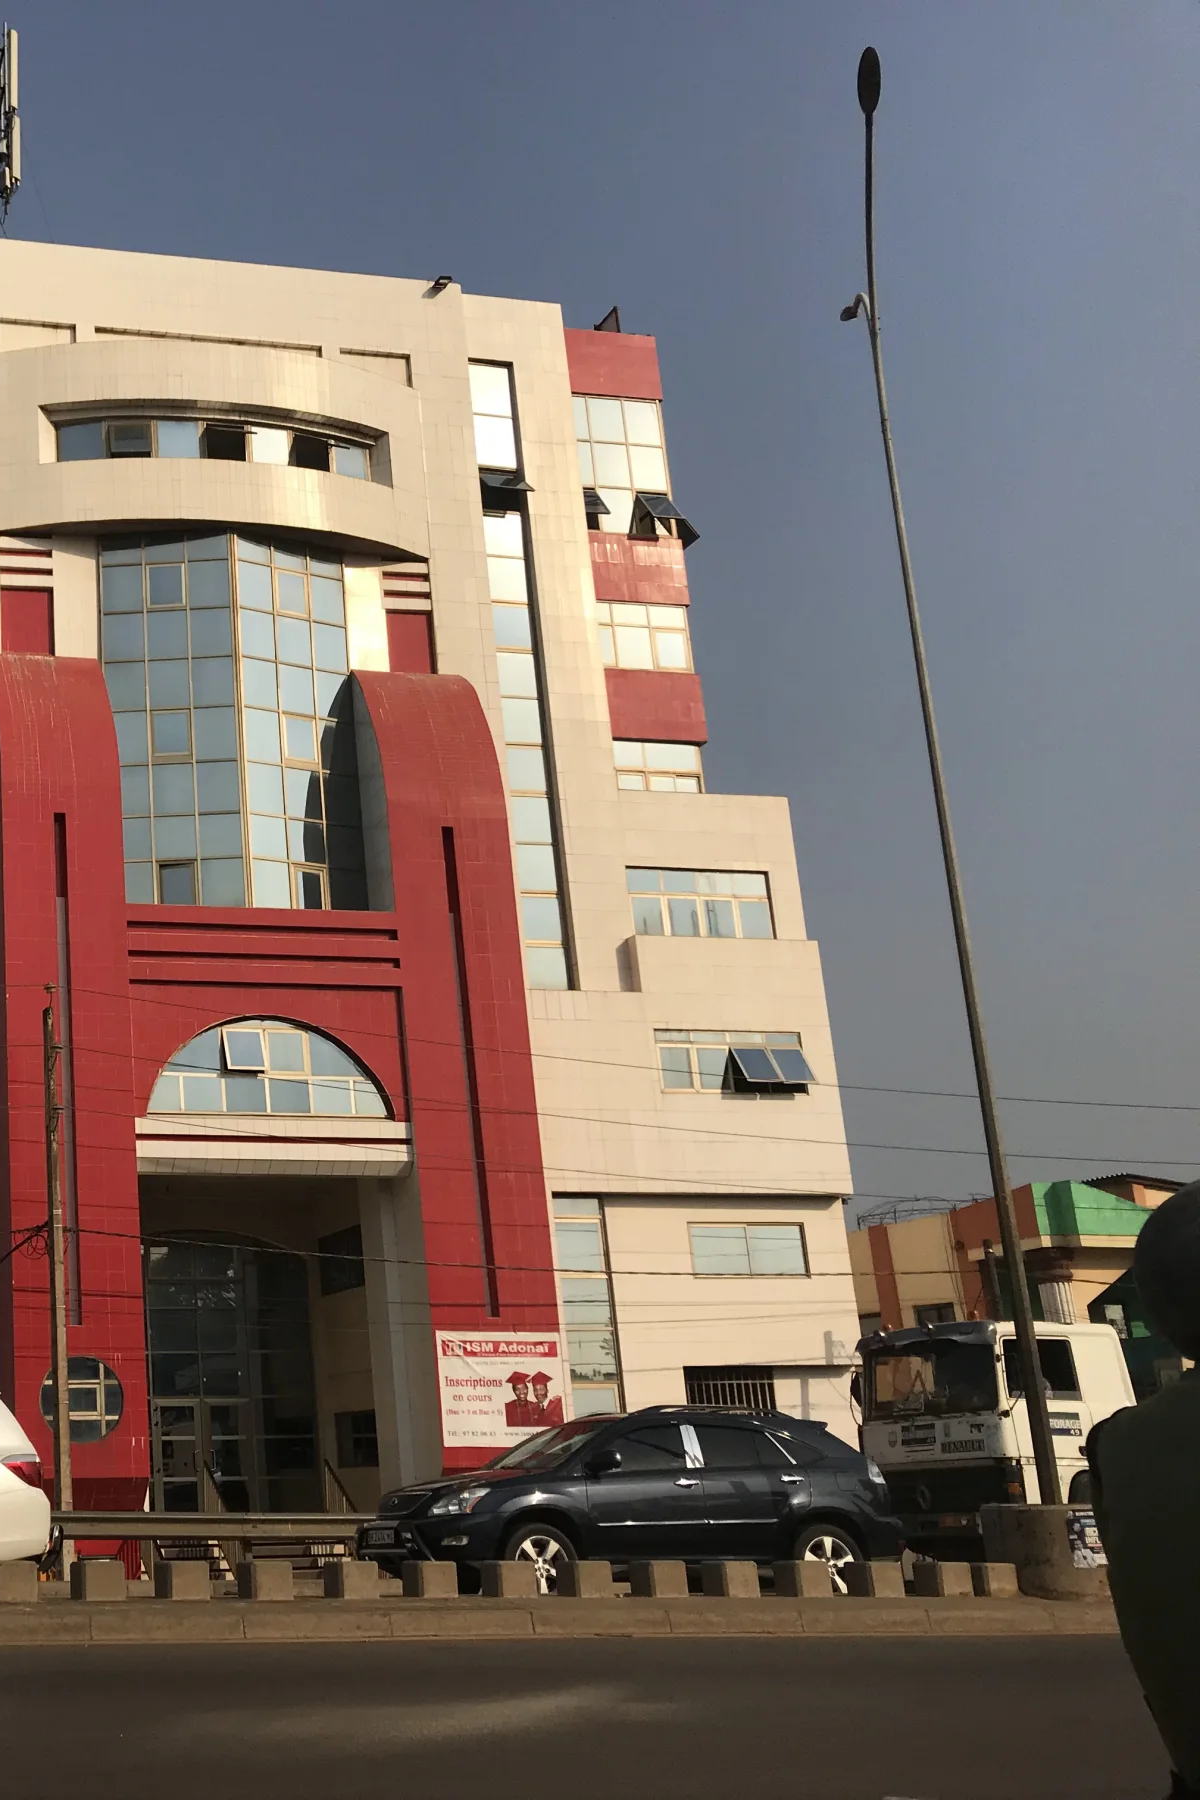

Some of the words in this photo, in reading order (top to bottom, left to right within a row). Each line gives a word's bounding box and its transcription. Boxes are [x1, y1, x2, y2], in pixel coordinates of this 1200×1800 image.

[466, 1341, 494, 1353] ISM
[498, 1342, 549, 1353] Adonaï
[445, 1376, 503, 1390] Inscriptions
[452, 1393, 464, 1402] en
[466, 1394, 493, 1402] cours
[940, 1439, 986, 1454] RENAULT
